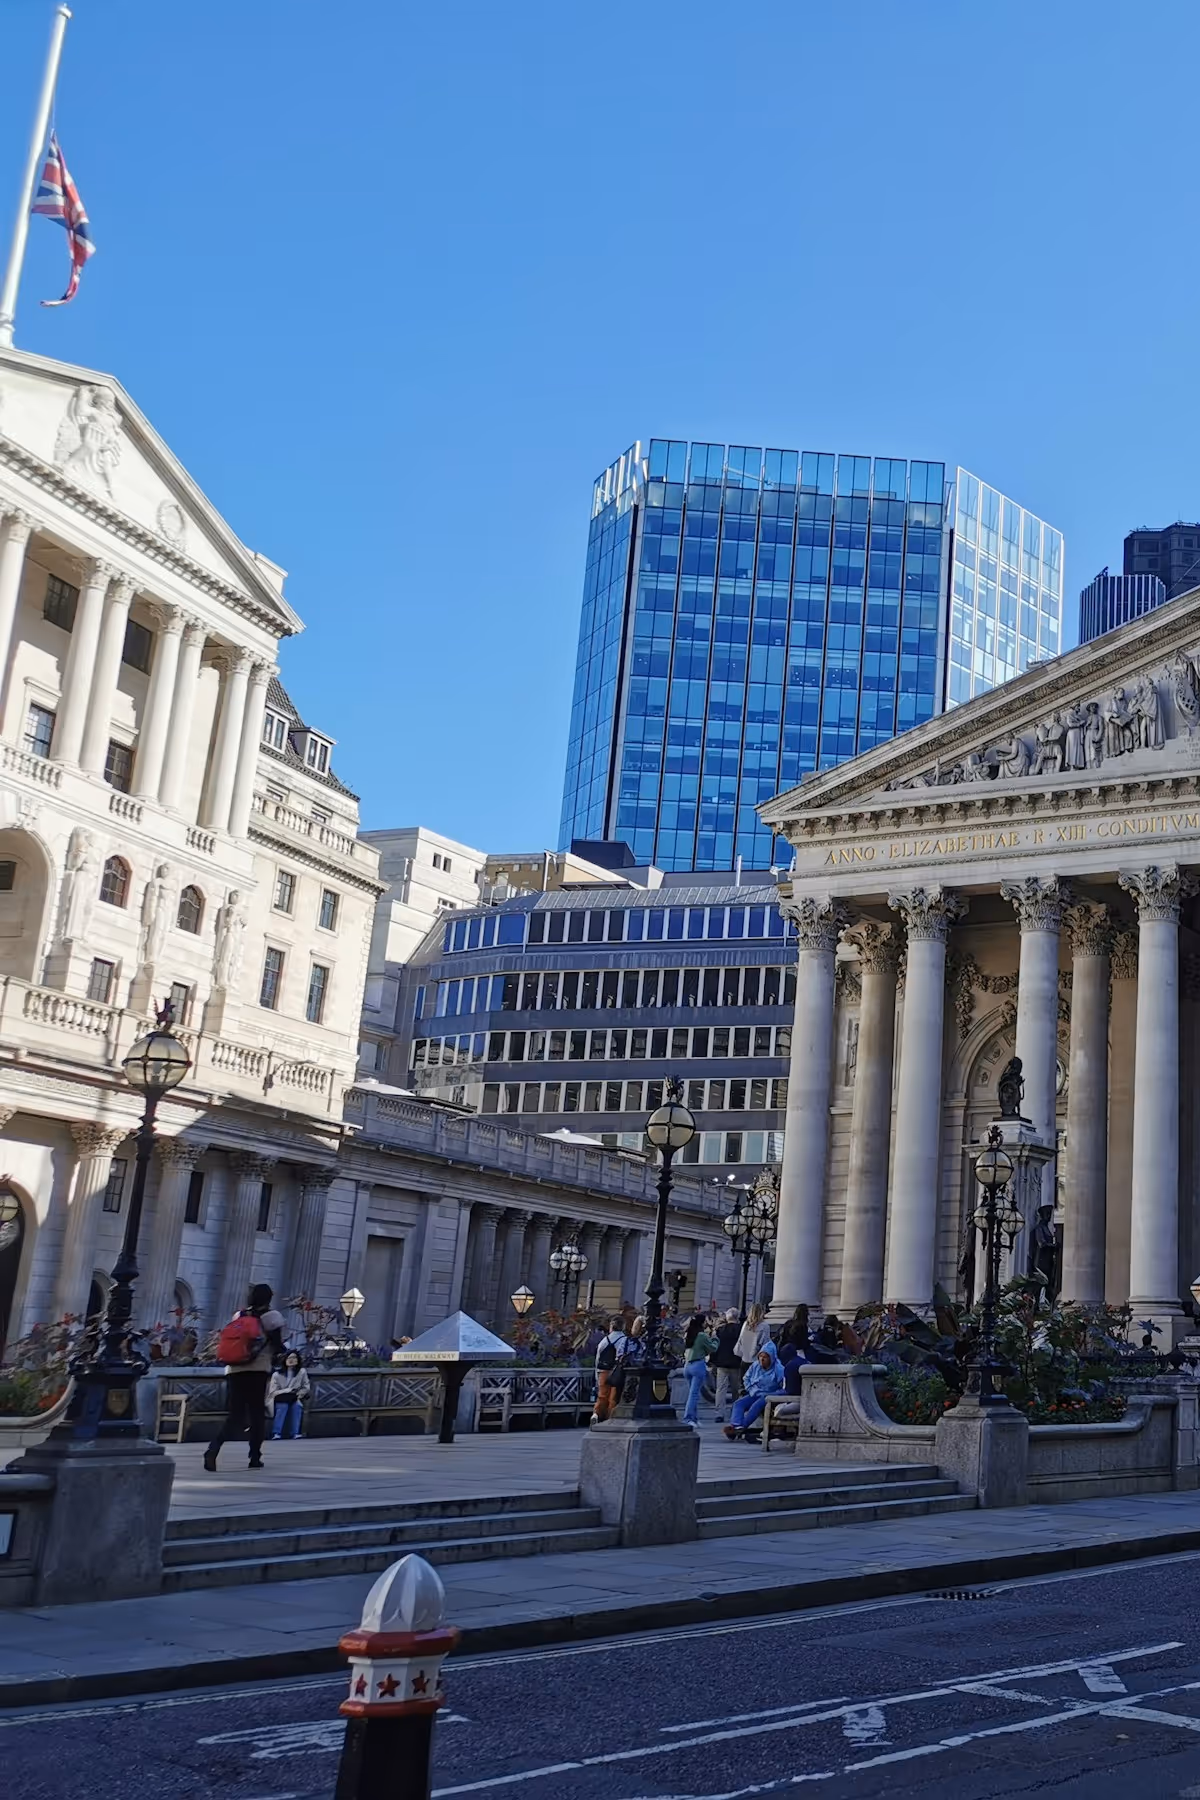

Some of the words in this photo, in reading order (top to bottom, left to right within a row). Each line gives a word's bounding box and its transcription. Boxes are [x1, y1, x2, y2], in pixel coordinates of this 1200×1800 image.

[823, 846, 876, 865] ANNO
[889, 831, 1021, 859] ELIZABETHAE
[1033, 829, 1045, 844] R
[1056, 825, 1086, 841] XIII
[1097, 813, 1200, 837] CONDITVM
